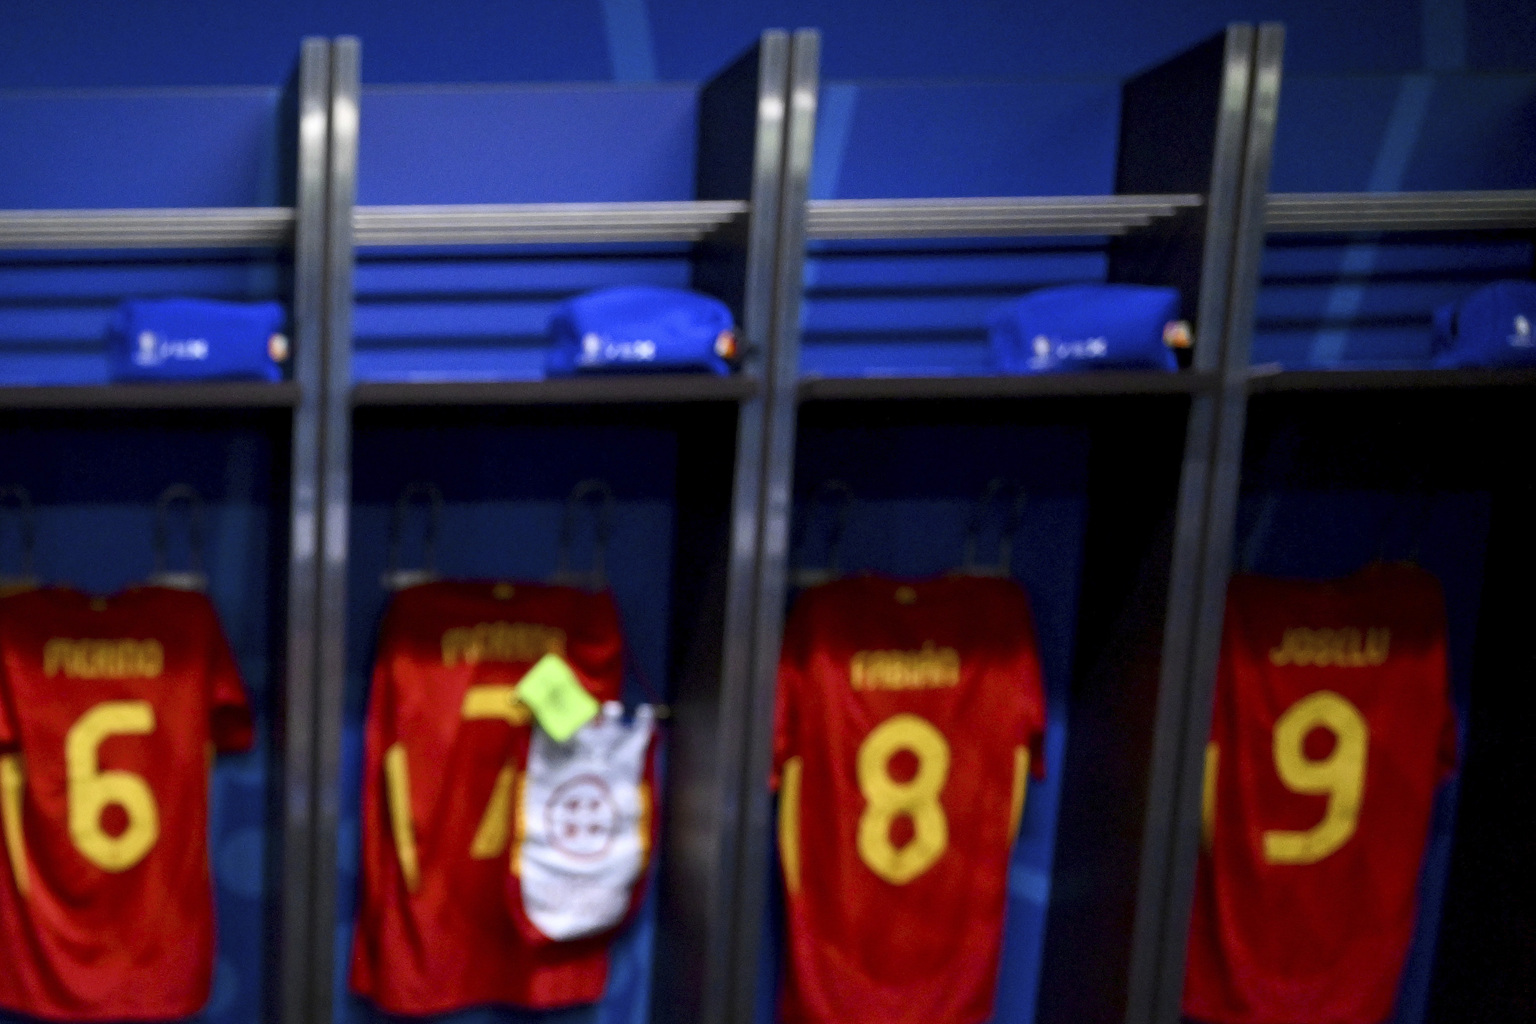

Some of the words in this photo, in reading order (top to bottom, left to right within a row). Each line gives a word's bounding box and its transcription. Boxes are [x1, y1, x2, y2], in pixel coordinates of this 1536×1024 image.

[65, 702, 158, 870] 6
[857, 715, 951, 884] 8
[1264, 692, 1369, 864] 9
